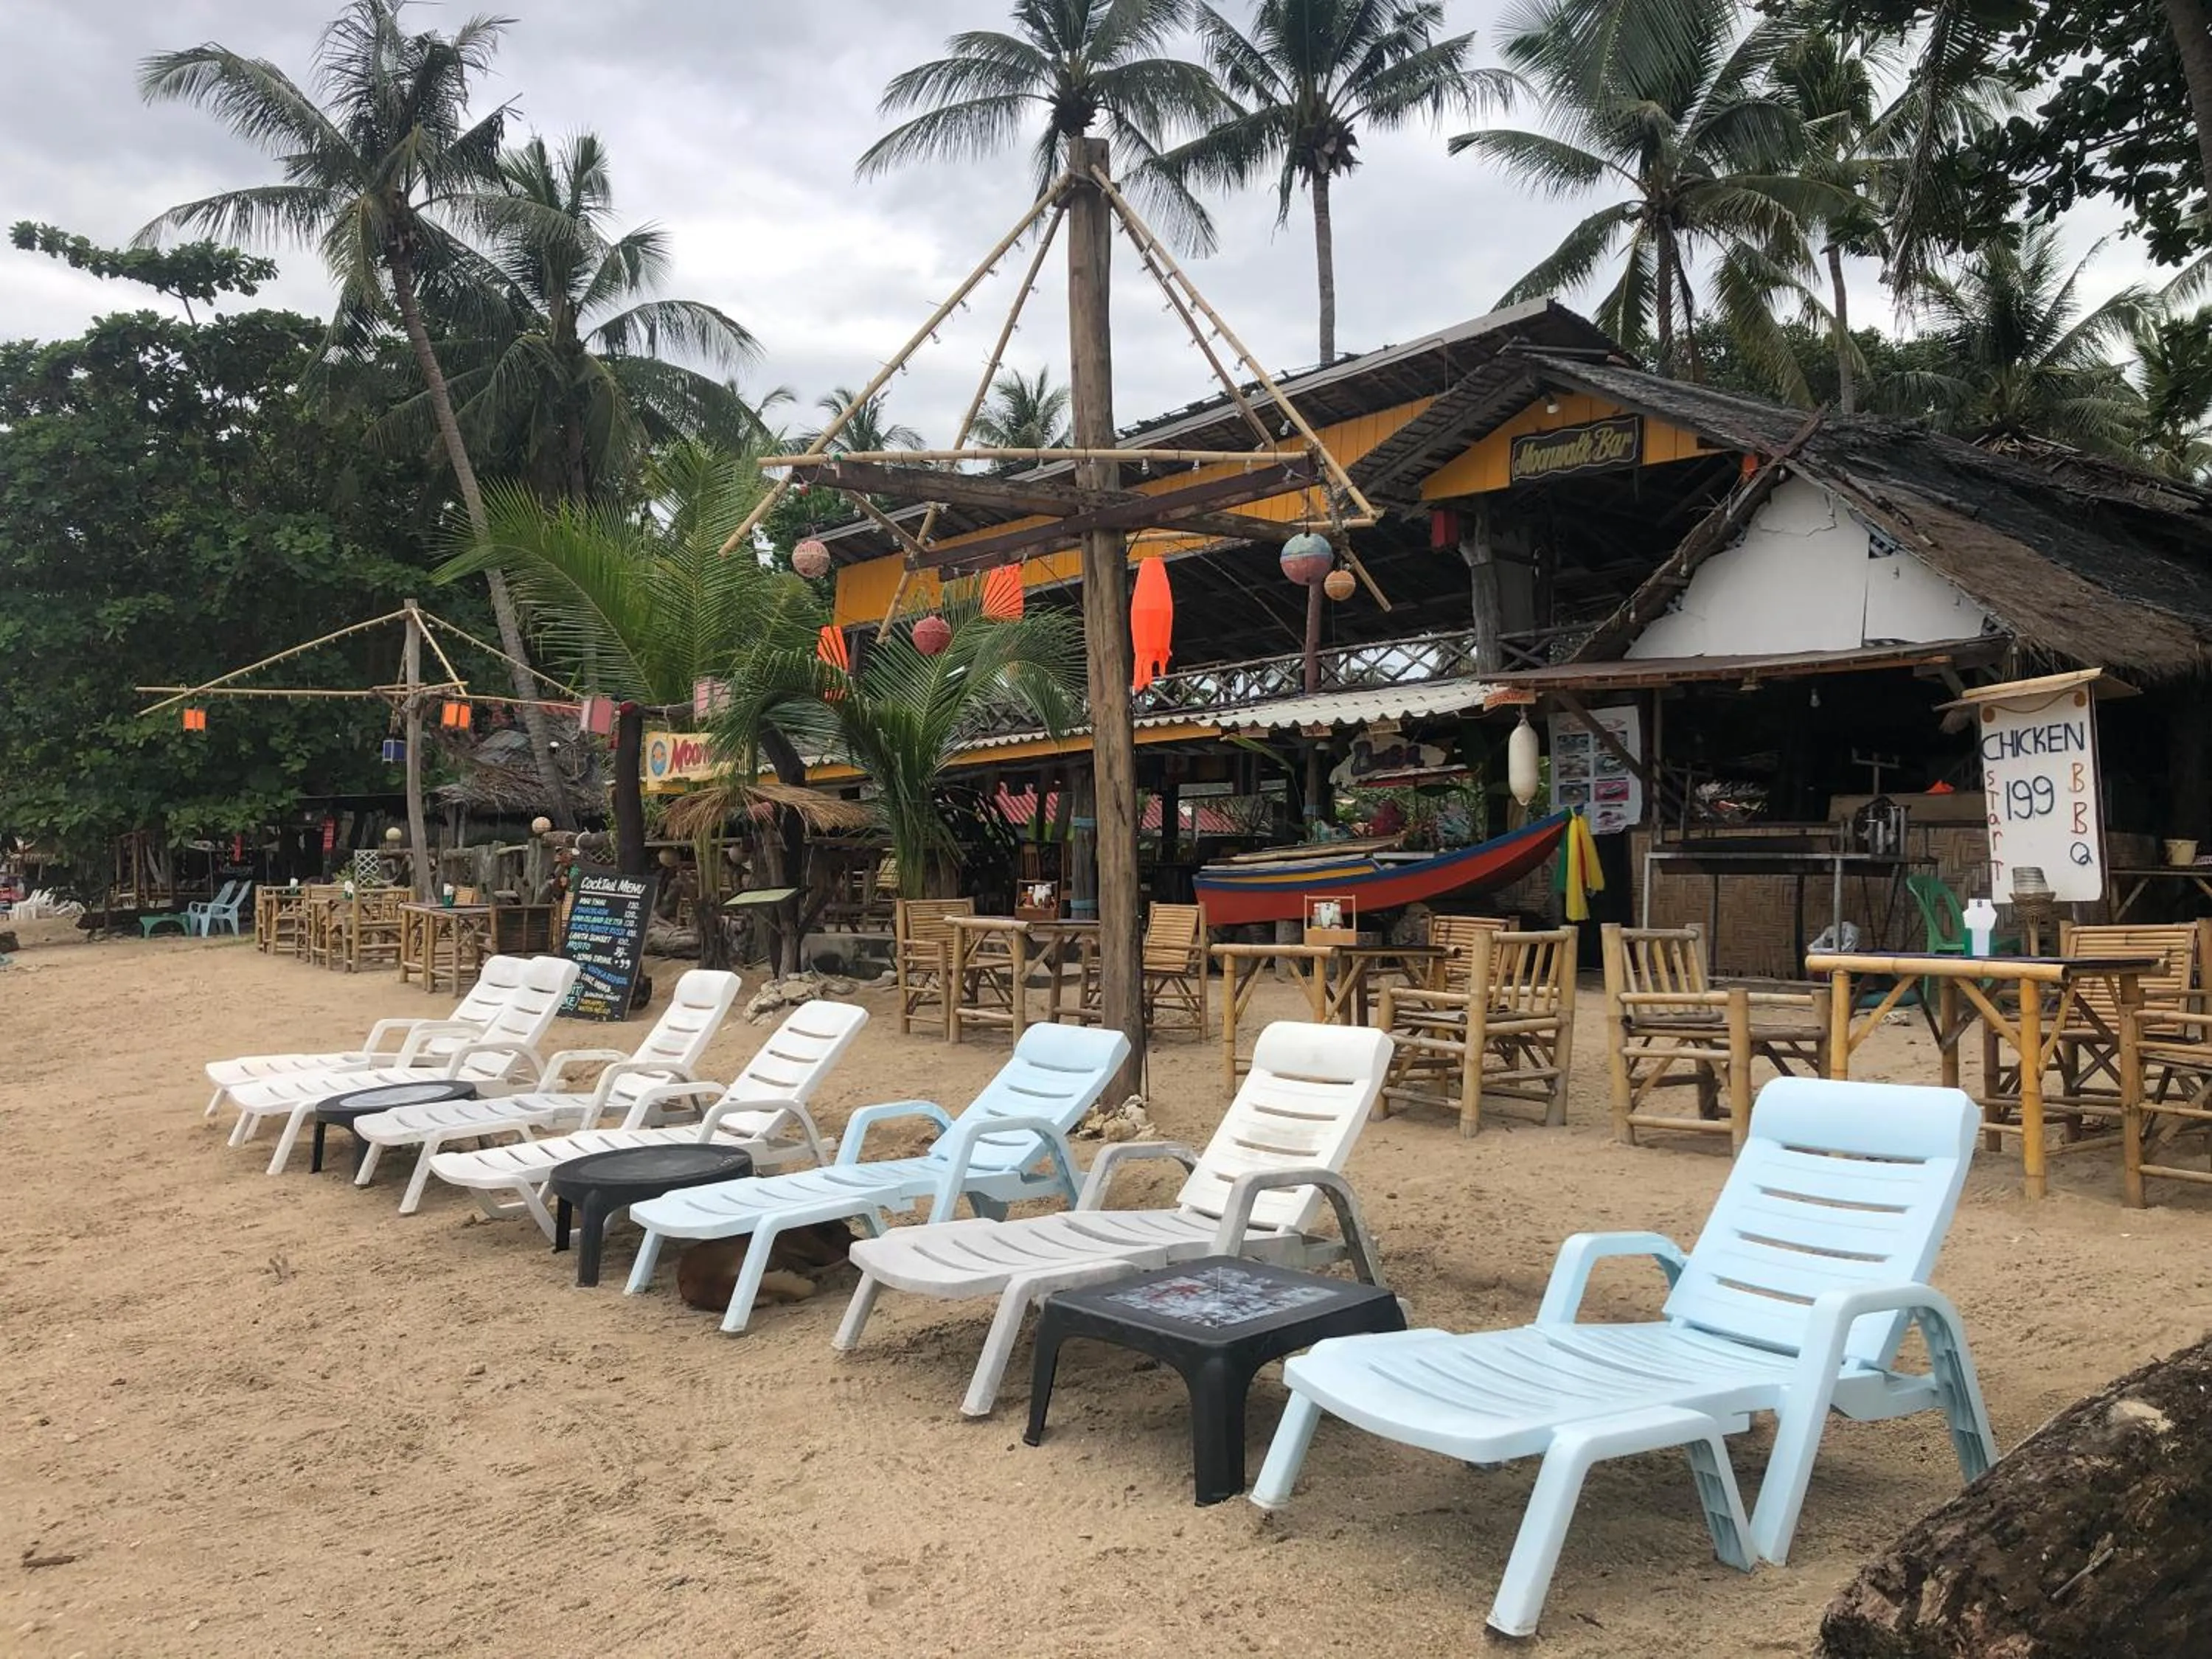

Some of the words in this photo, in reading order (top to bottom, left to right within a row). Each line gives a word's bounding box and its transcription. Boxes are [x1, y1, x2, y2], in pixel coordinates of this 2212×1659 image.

[1592, 426, 1634, 462] Bar
[1980, 720, 2085, 761] CHICKEN
[2006, 775, 2055, 821] 199
